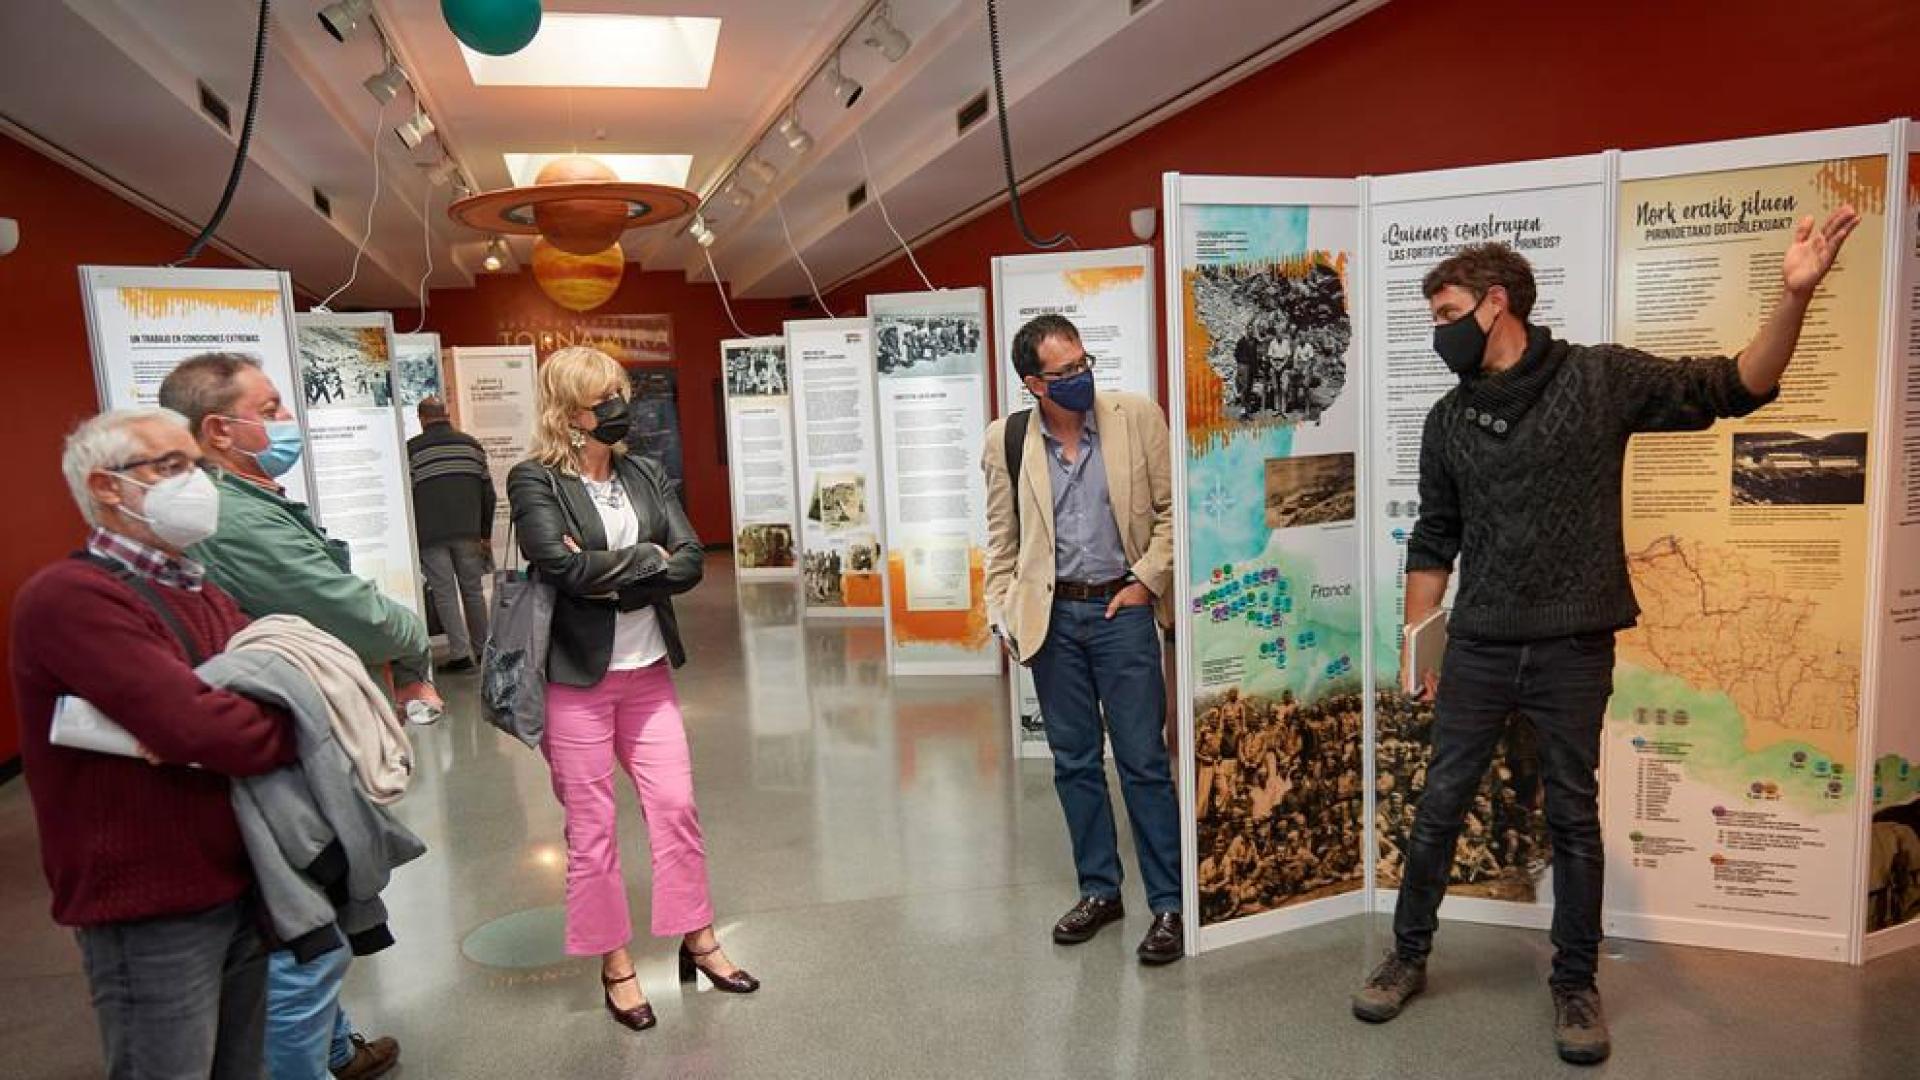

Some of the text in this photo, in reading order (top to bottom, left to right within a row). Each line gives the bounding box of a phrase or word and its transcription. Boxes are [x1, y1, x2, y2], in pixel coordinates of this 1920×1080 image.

[1636, 201, 1676, 226] Nork
[1683, 196, 1734, 224] eraiki
[1455, 213, 1542, 243] construyen
[1388, 247, 1405, 261] LAS
[130, 333, 260, 344] UN TRABAJO EN CONDICIONES EXTREMAS
[1311, 583, 1352, 600] France
